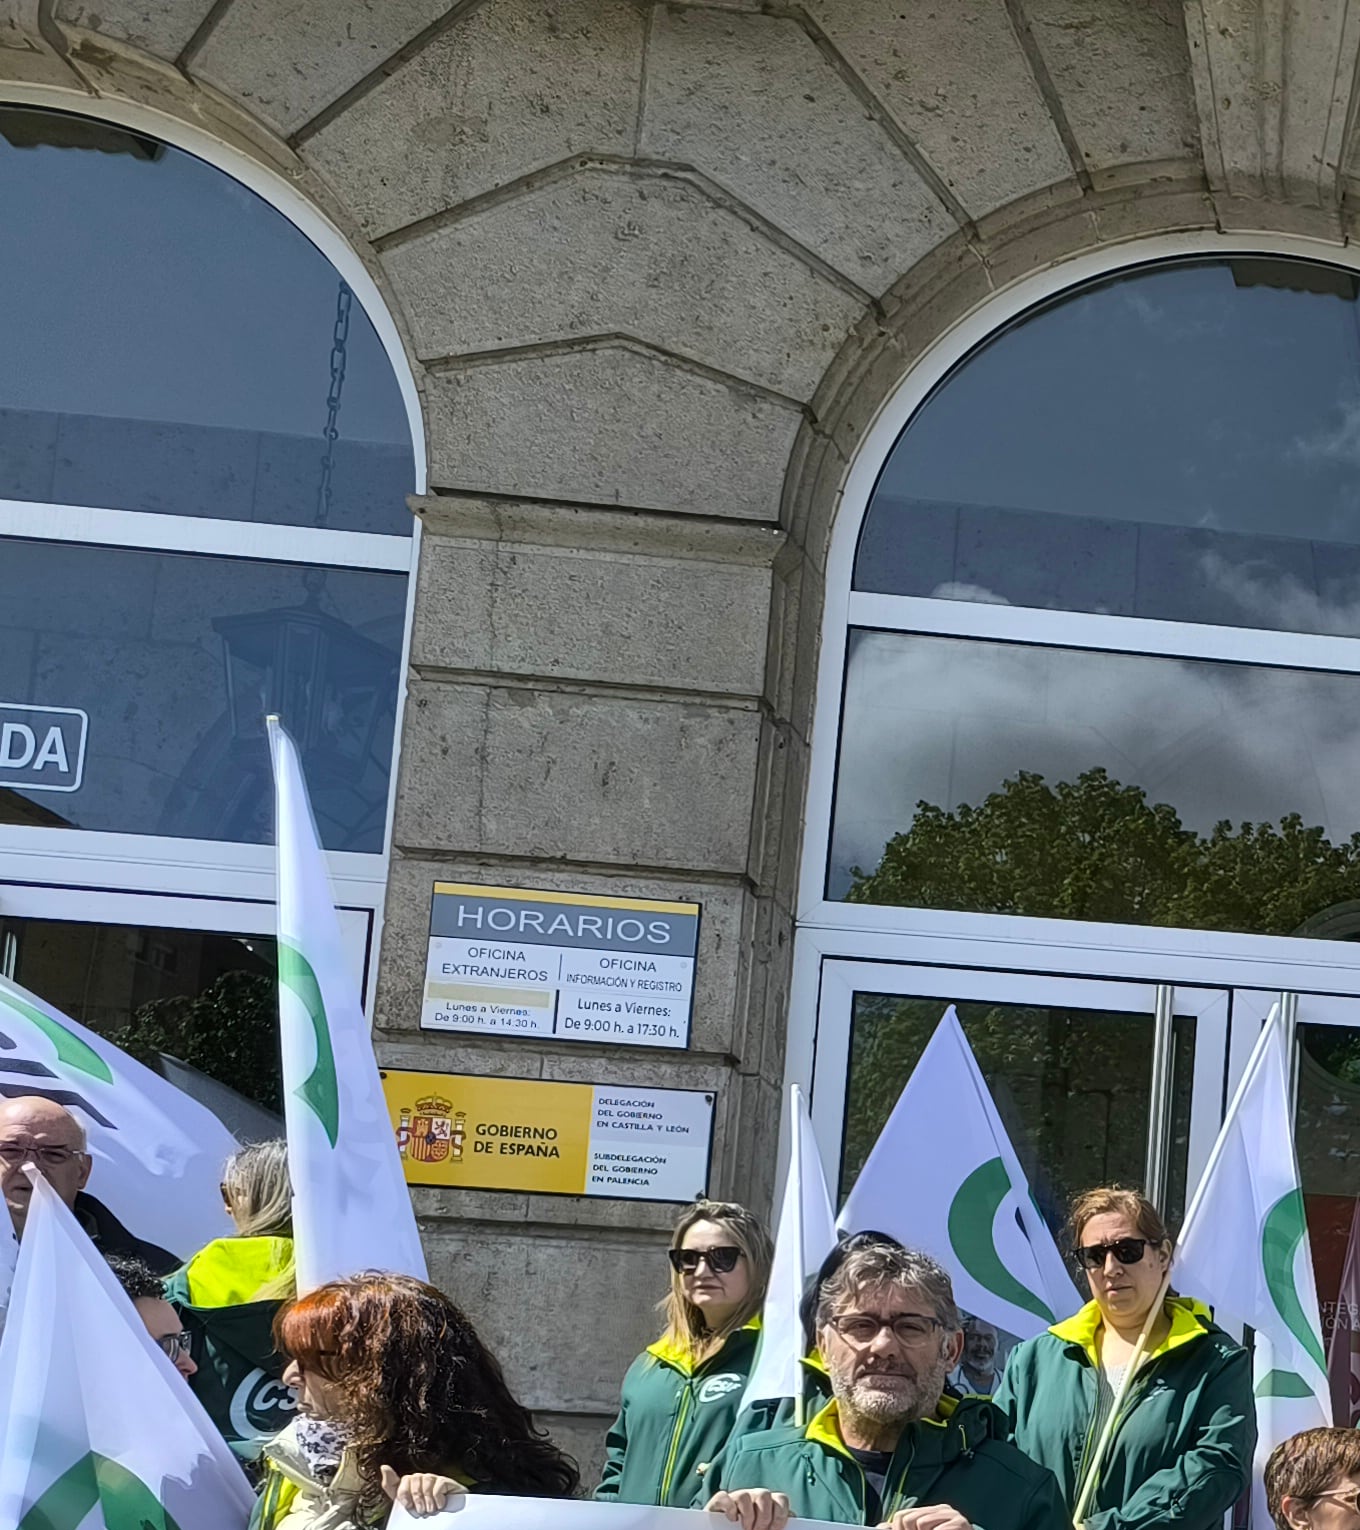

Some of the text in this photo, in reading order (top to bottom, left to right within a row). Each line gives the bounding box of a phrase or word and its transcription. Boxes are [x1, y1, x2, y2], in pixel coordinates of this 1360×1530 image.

[457, 905, 671, 943] HORARIOS
[468, 947, 526, 962] OFICINA
[442, 963, 548, 981] EXTRANJEROS
[600, 957, 657, 973] OFICINA
[566, 973, 682, 993] INFORMACIÓN Y REGISTRO
[446, 1002, 478, 1013] Lunes
[480, 1005, 487, 1013] a
[577, 997, 671, 1018] Lunes a Viernes:
[435, 1012, 450, 1022] De
[489, 1017, 497, 1026] a
[564, 1017, 680, 1039] De 9:00 h. a 17:30 h.
[598, 1098, 655, 1109] DELEGACIÓN
[597, 1109, 663, 1120] DEL GOBIERNO
[475, 1123, 558, 1140] GOBIERNO
[596, 1120, 609, 1128] EN
[611, 1121, 654, 1132] CASTILLA
[666, 1124, 690, 1134] LEÓN
[474, 1140, 560, 1159] DE ESPAÑA
[593, 1152, 667, 1165] SUBDELEGACIÓN
[592, 1164, 659, 1176] DEL GOBIERNO
[591, 1175, 650, 1187] EN PALENCIA
